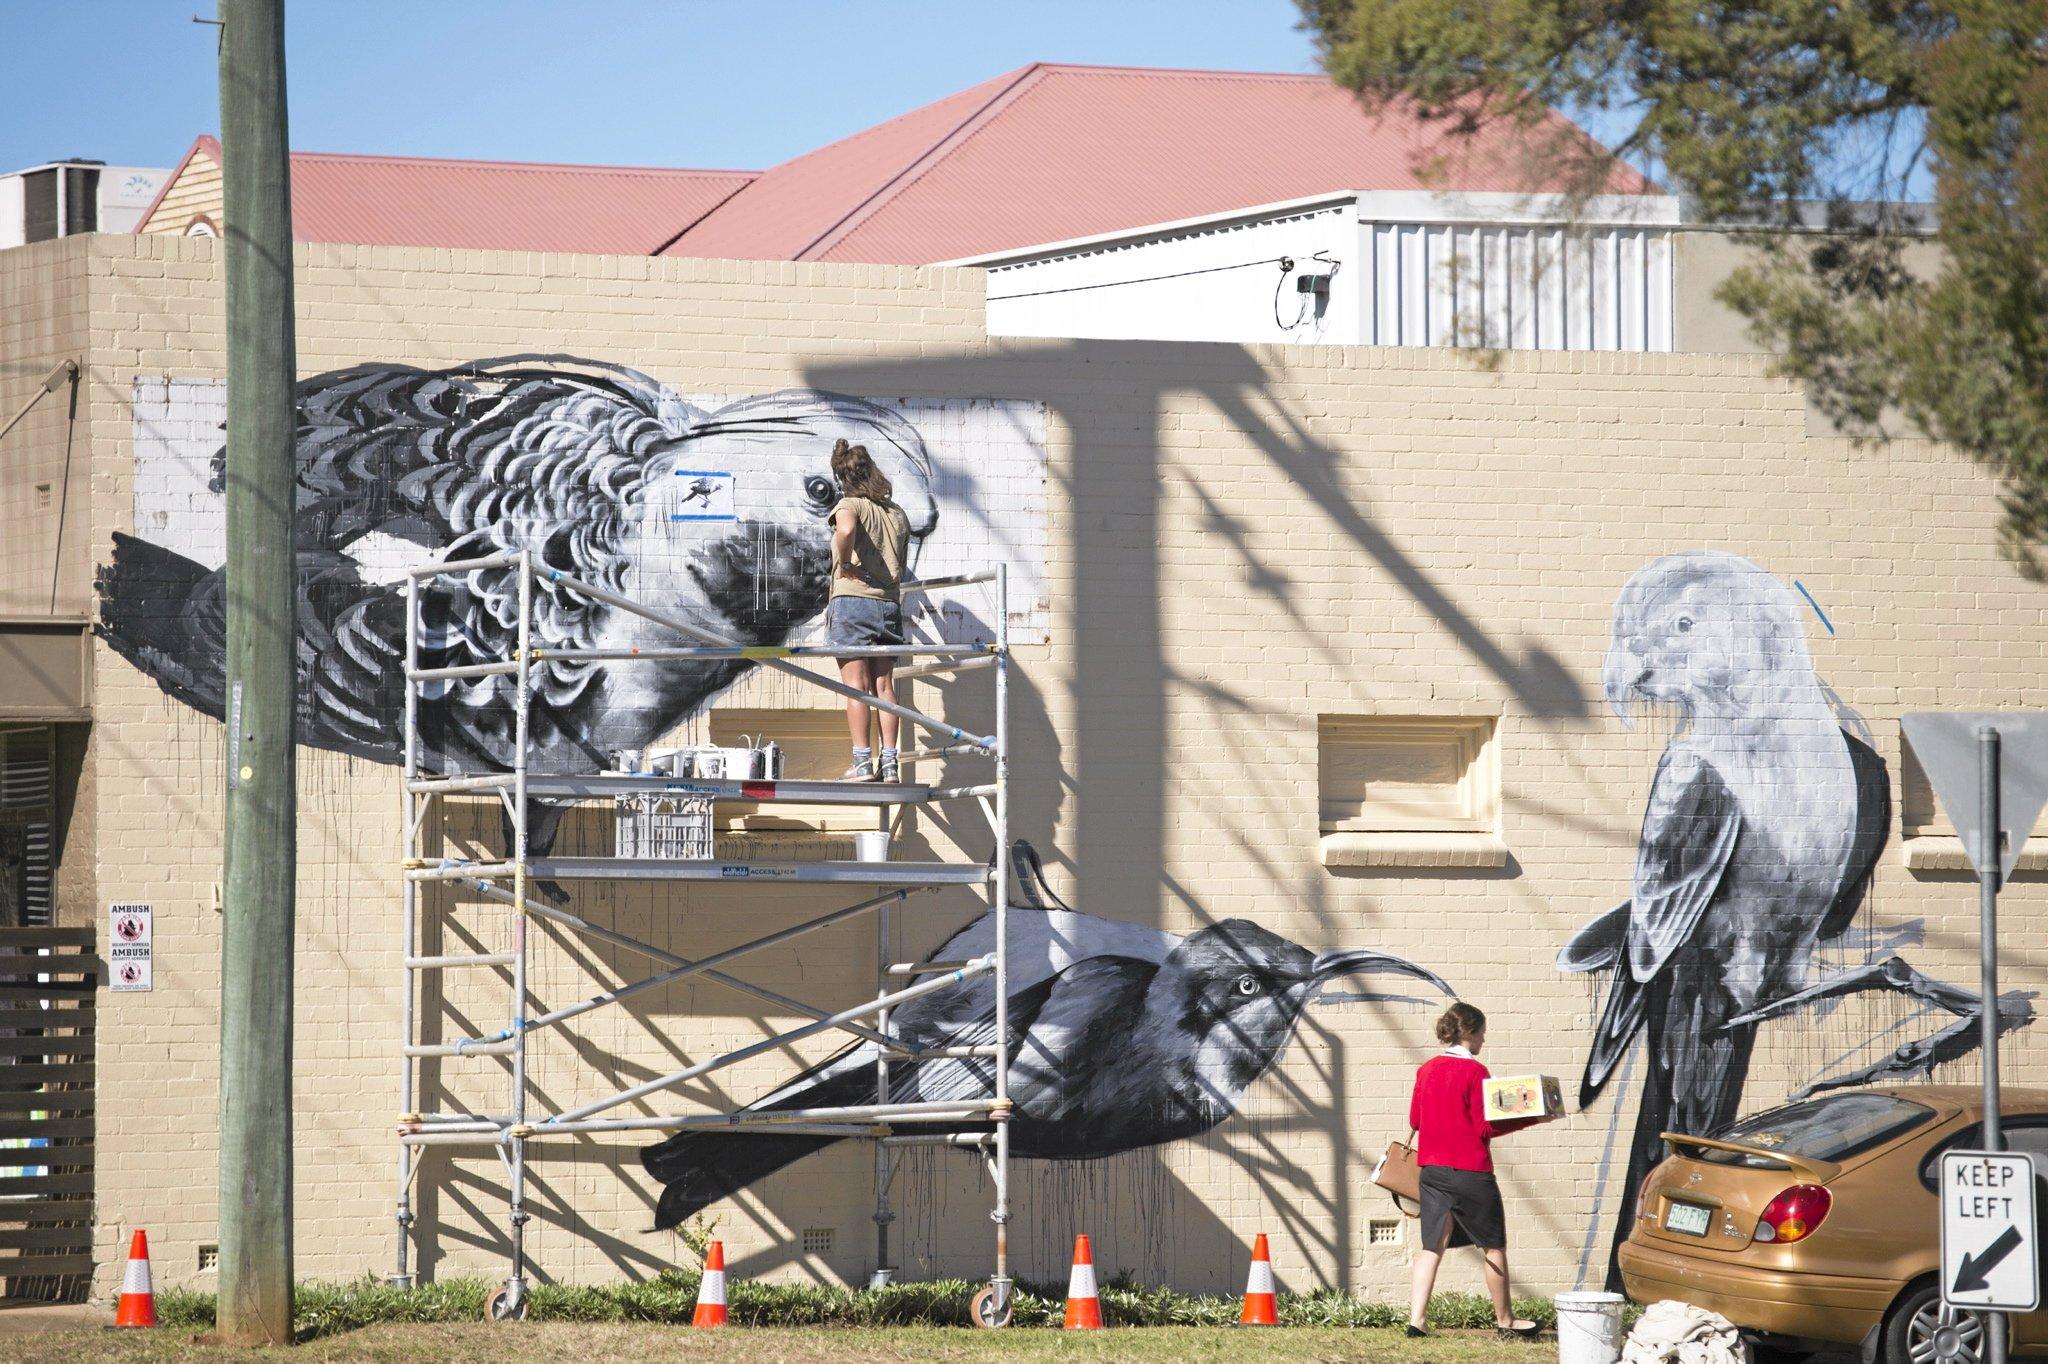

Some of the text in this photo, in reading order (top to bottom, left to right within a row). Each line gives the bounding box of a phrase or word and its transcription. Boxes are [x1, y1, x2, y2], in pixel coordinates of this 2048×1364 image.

[111, 905, 150, 913] AMBUSH
[111, 948, 150, 956] AMBUSH
[1957, 1164, 2014, 1188] KEEP
[1960, 1196, 2013, 1219] LEFT
